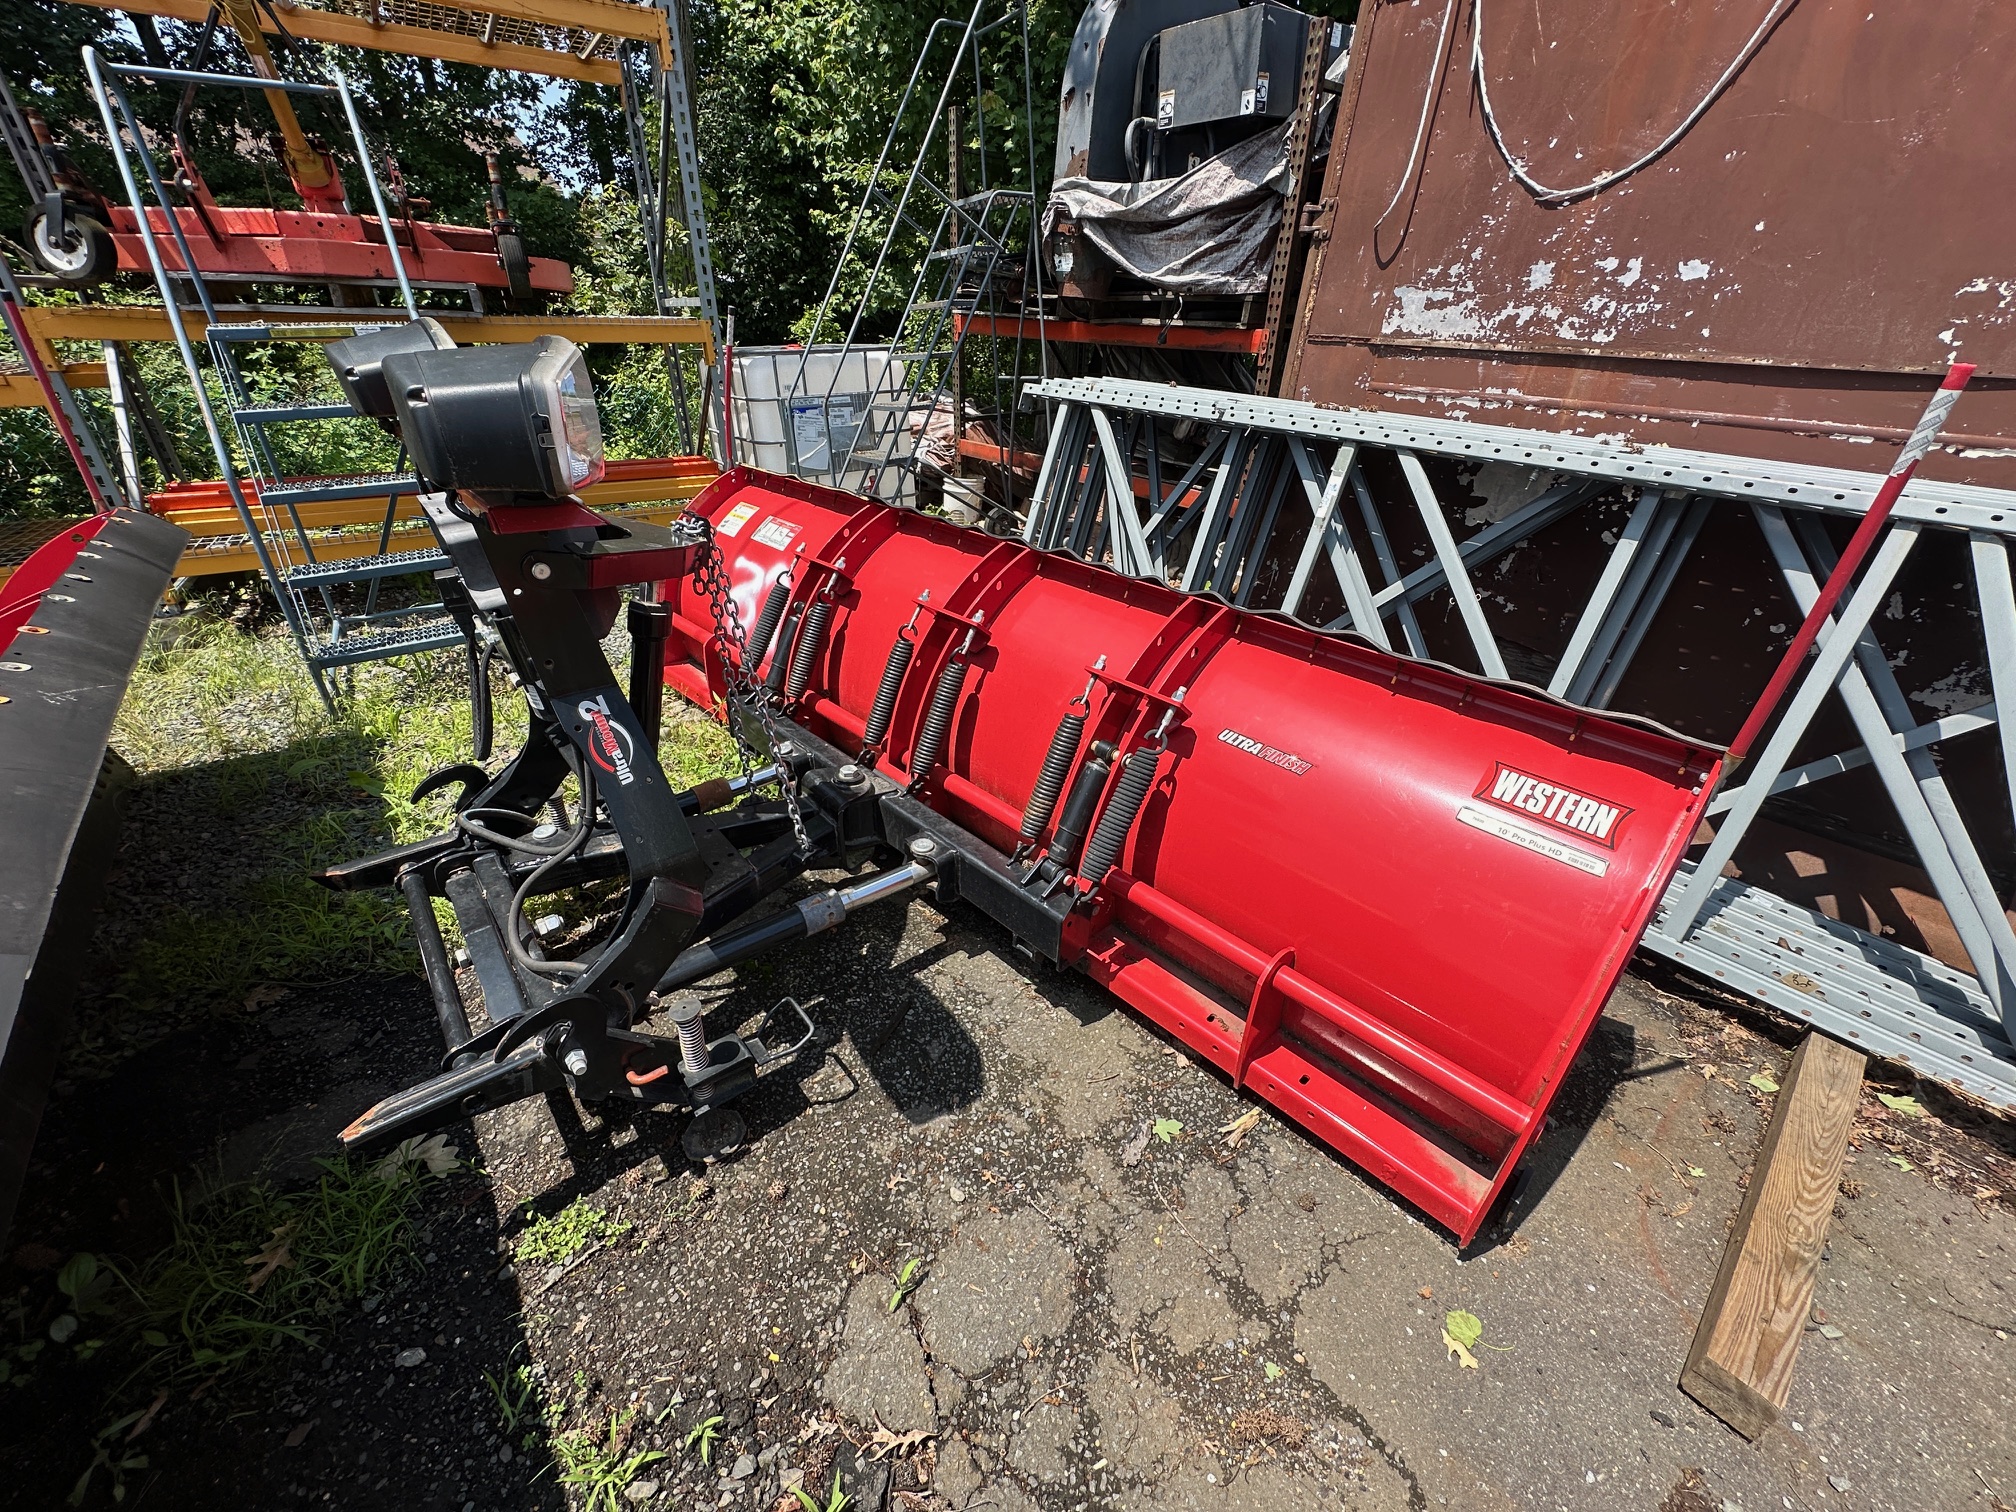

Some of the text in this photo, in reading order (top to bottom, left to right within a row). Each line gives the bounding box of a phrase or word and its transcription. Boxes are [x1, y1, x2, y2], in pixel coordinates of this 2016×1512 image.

[578, 694, 611, 721] 2
[1491, 769, 1620, 839] WESTERN
[1512, 832, 1527, 843] Pro
[1528, 839, 1546, 851] Plus
[1548, 847, 1563, 857] HD
